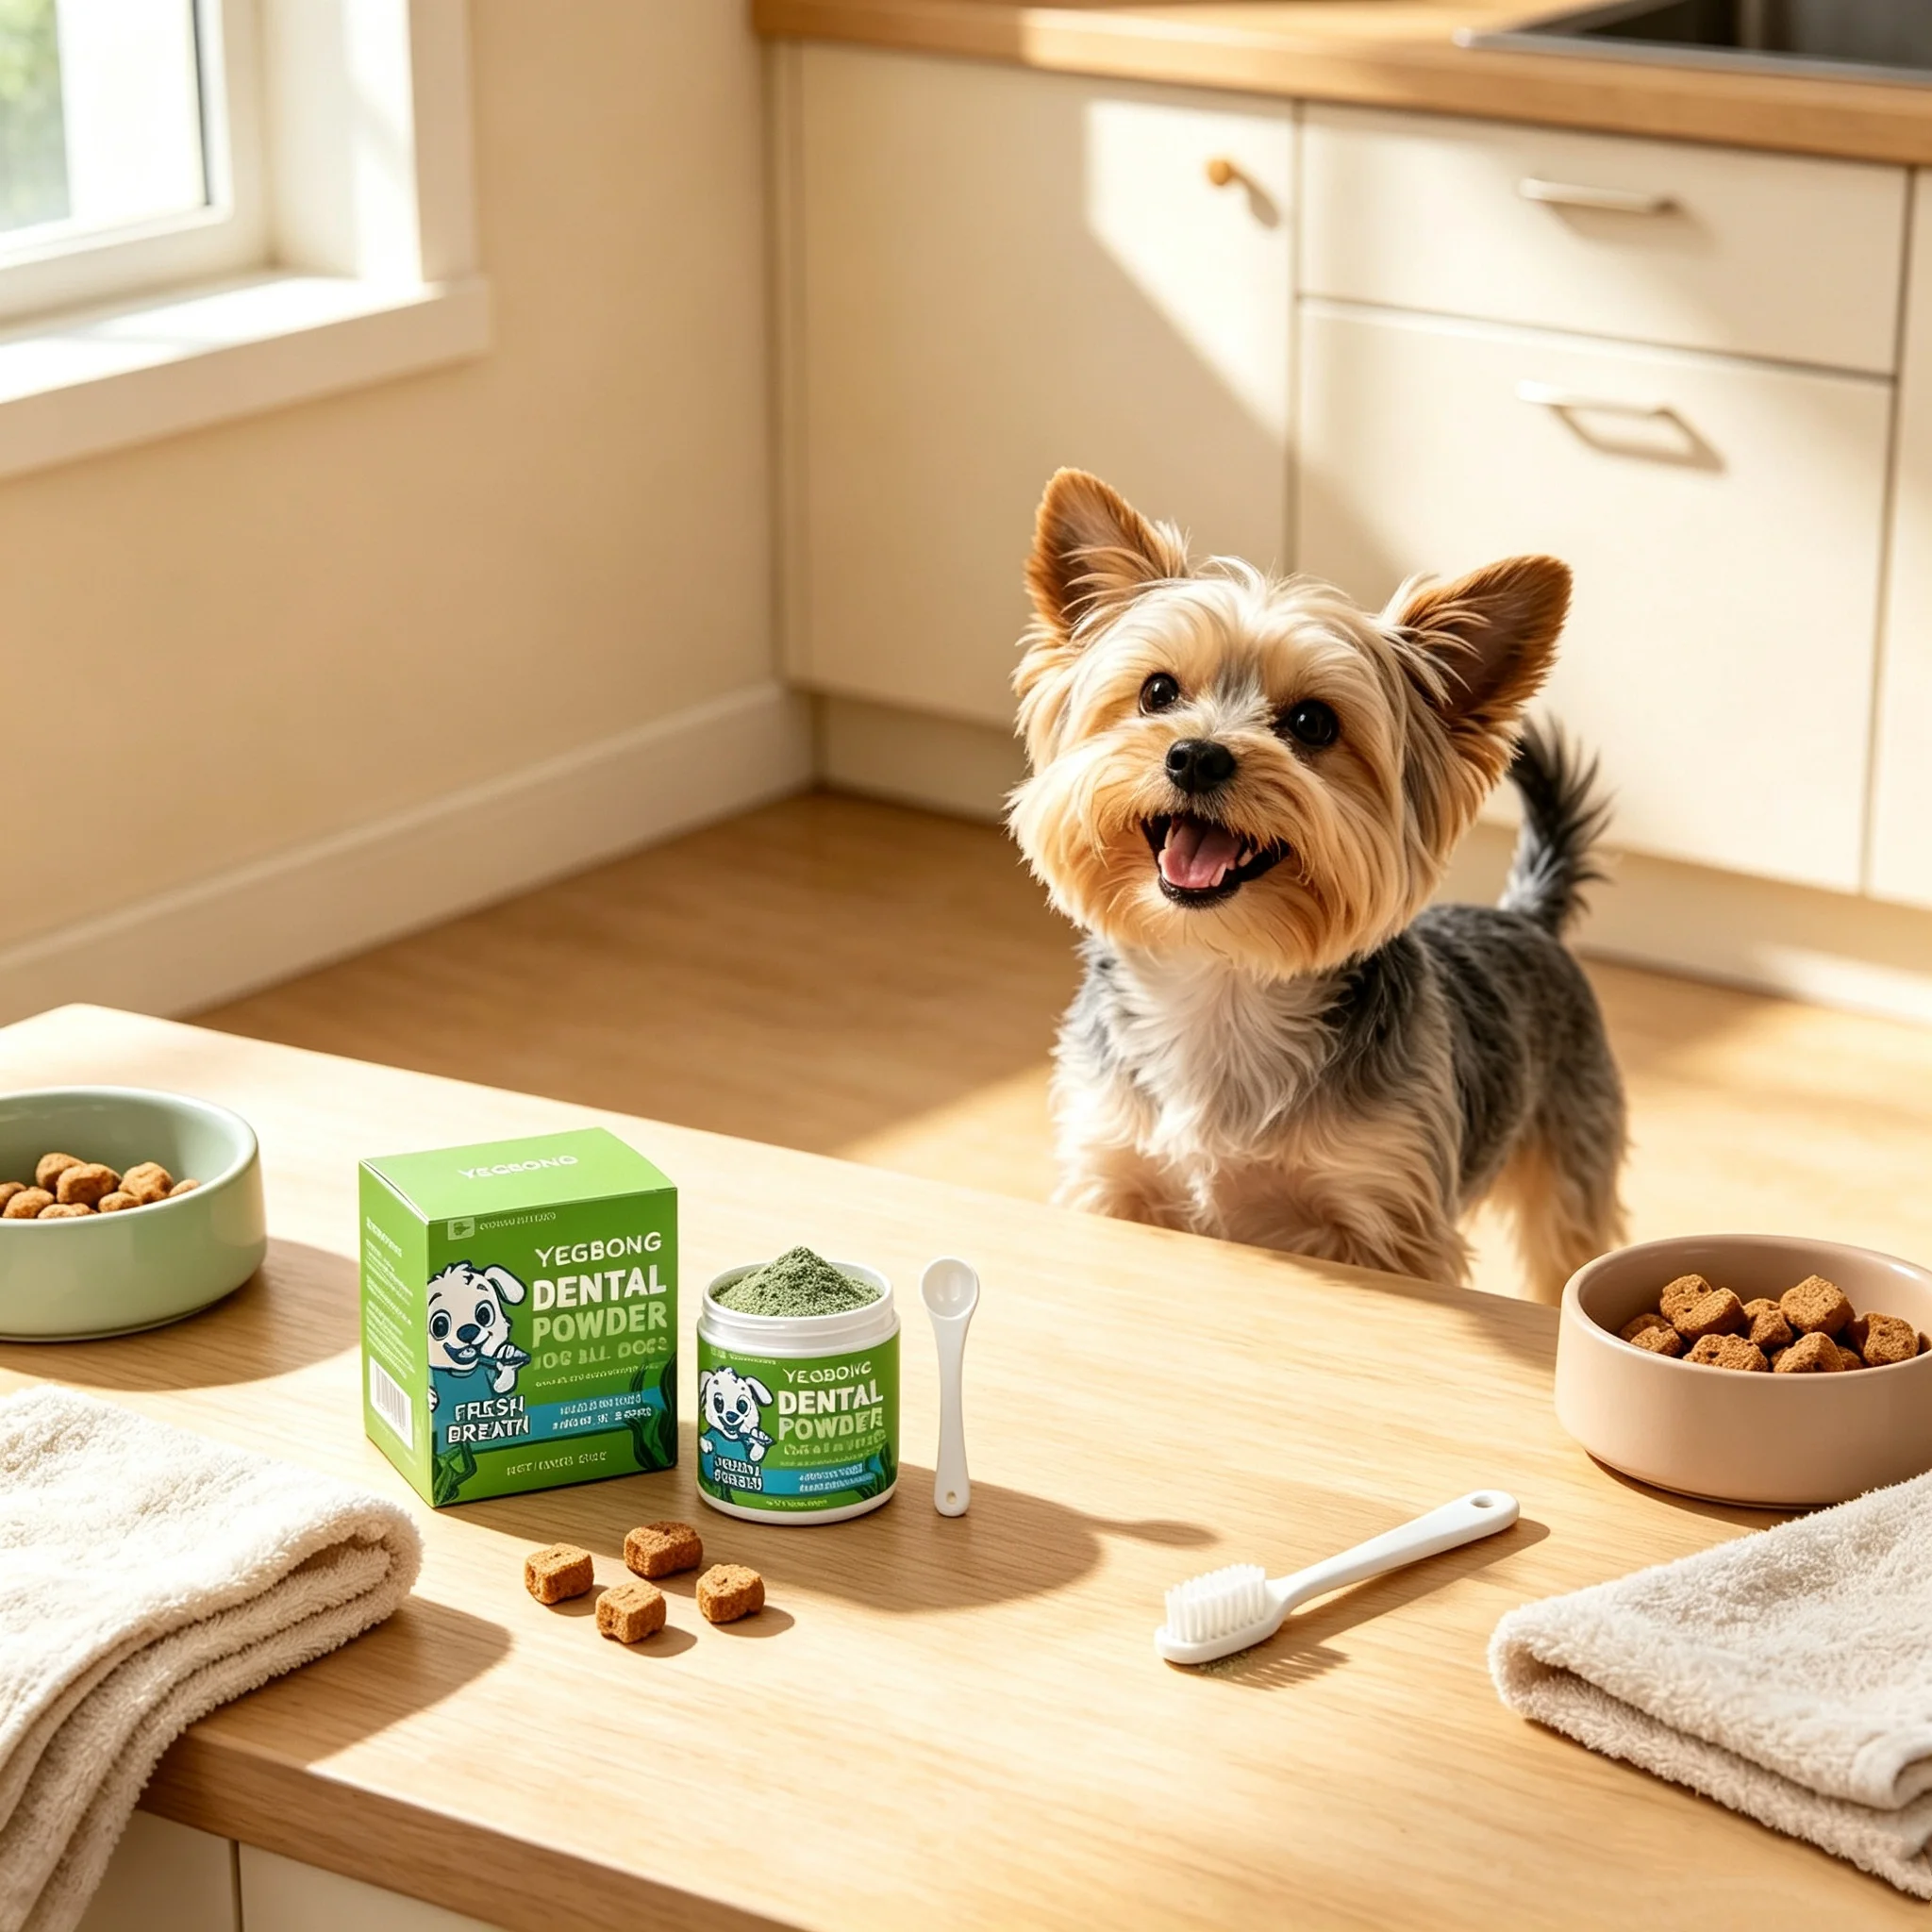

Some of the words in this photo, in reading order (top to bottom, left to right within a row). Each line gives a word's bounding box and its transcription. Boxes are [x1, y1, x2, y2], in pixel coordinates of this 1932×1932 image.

[535, 1231, 662, 1268] YEGBONG
[532, 1264, 667, 1312] DENTAL
[532, 1301, 668, 1349] POWDER
[777, 1379, 884, 1415] DENTAL
